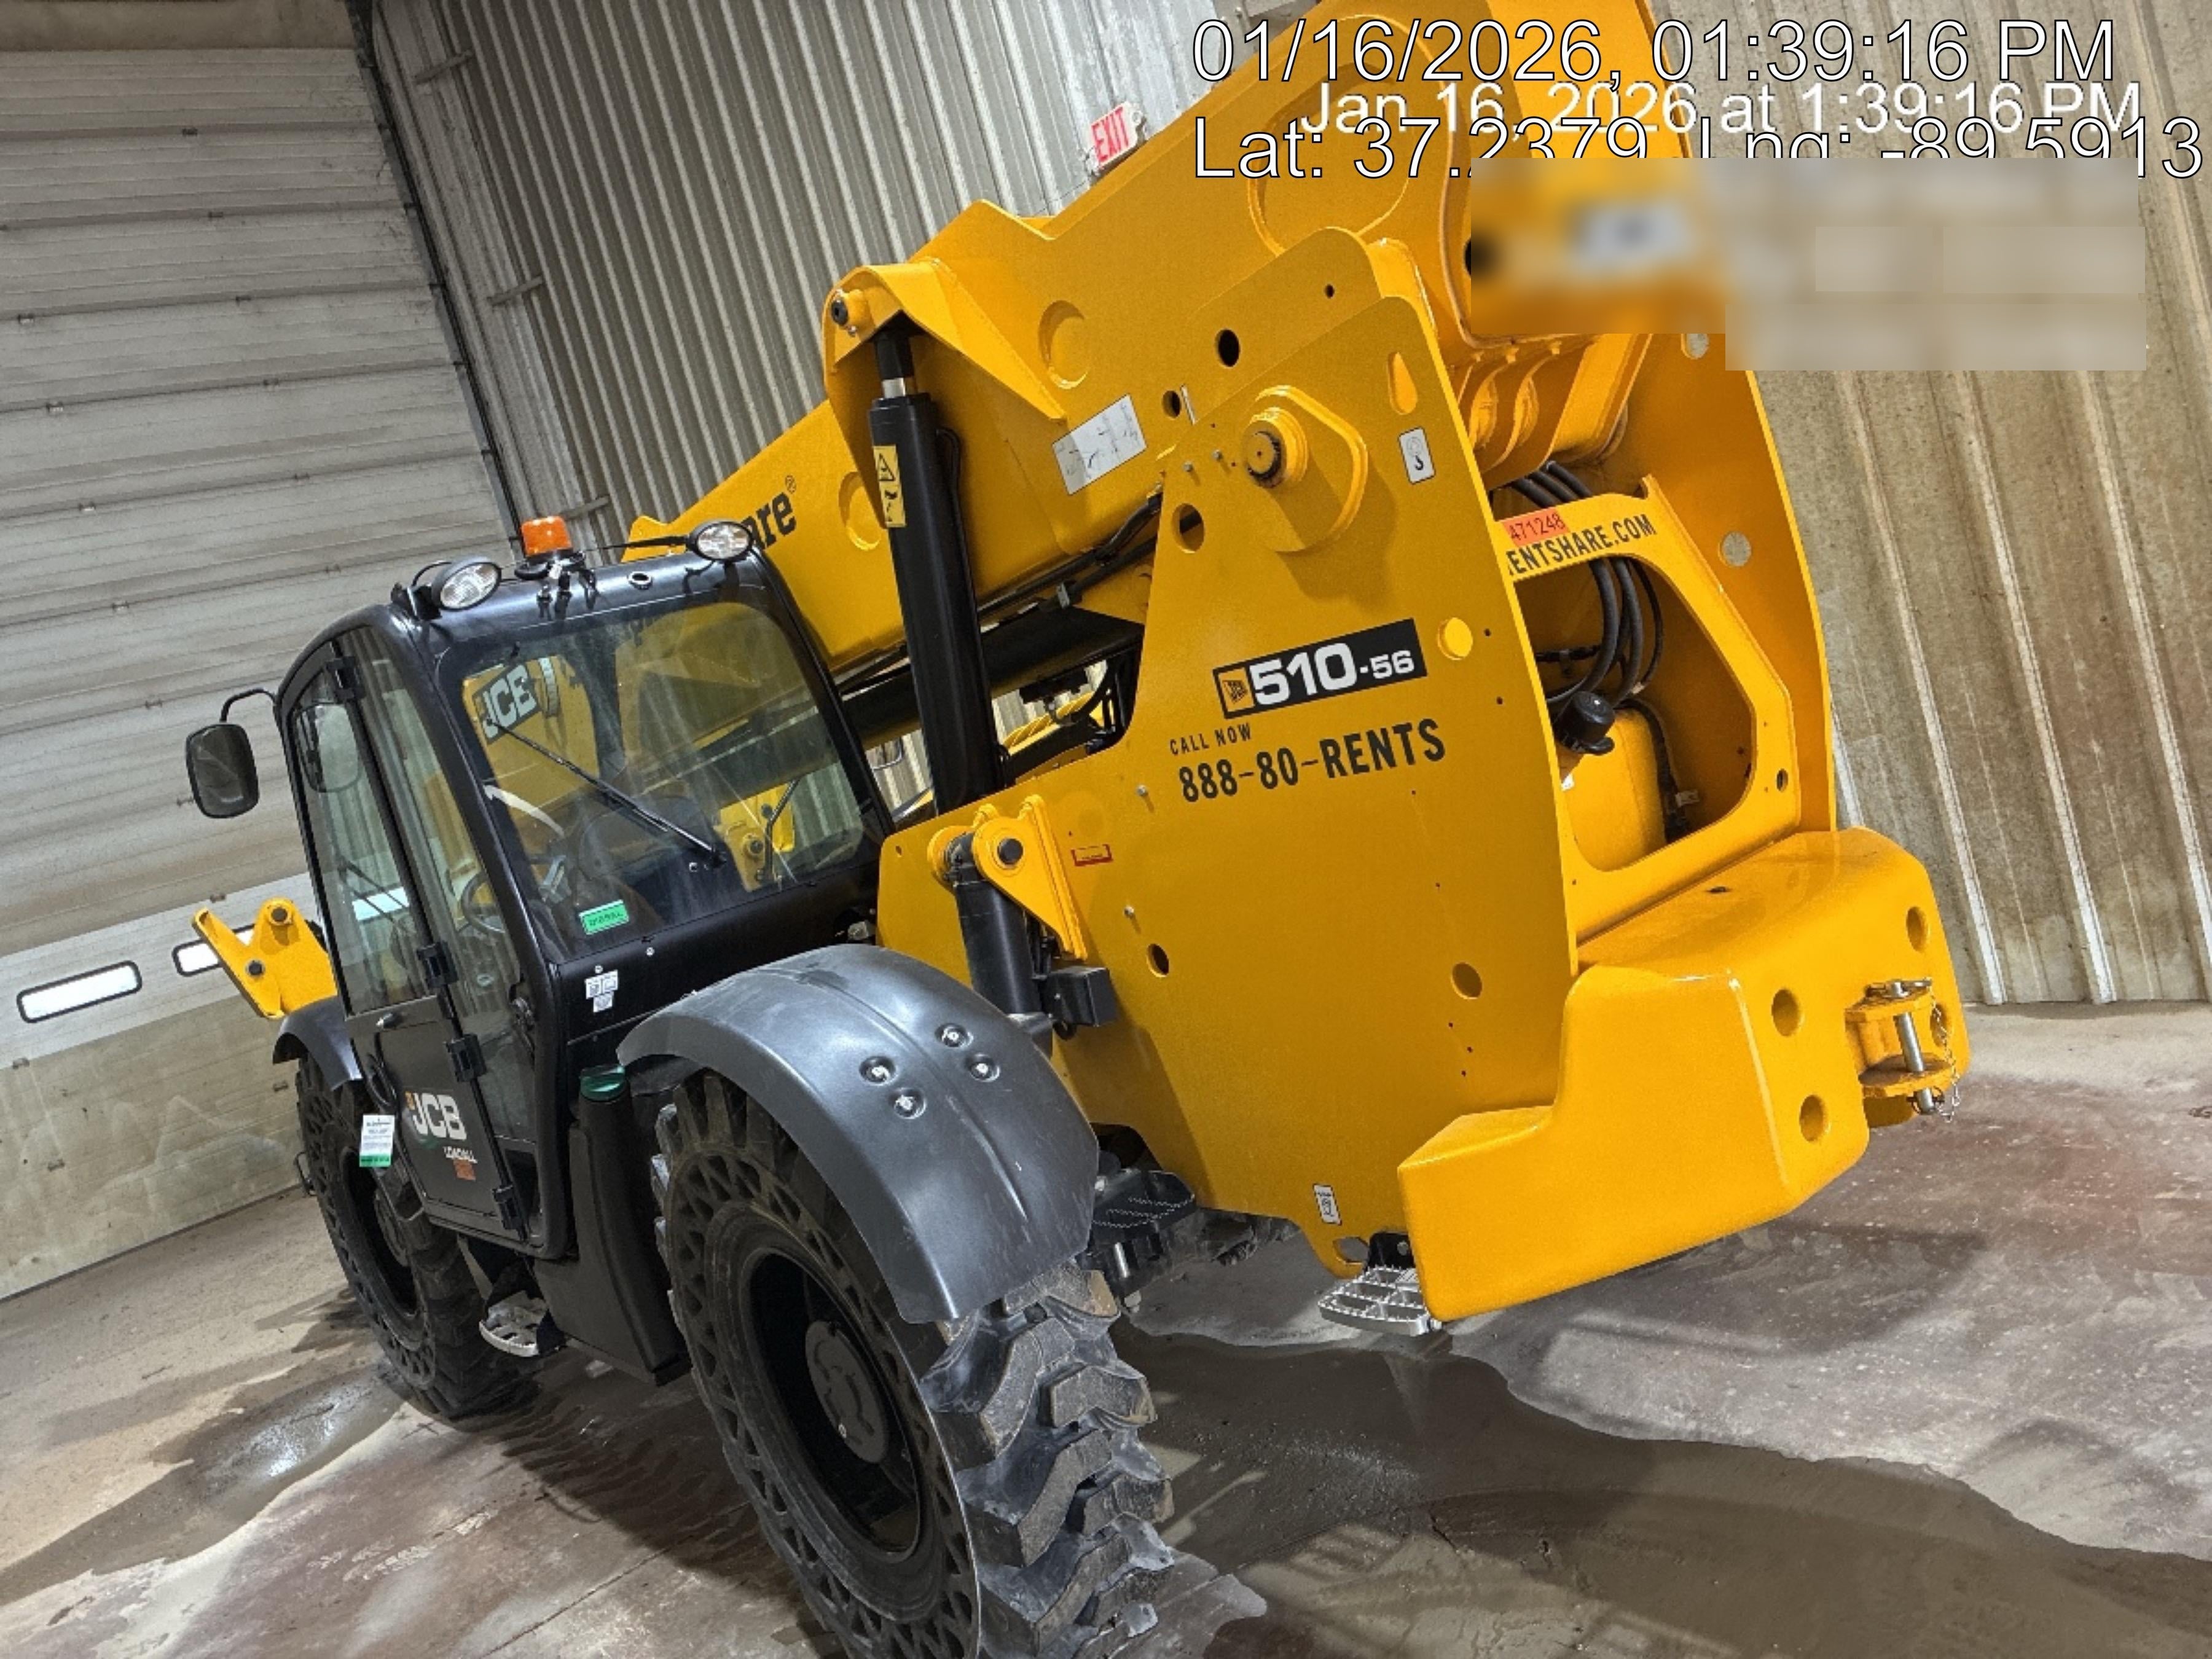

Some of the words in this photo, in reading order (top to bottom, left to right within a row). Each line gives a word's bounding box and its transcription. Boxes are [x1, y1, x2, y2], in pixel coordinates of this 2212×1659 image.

[1091, 106, 1129, 162] EXIT
[1507, 514, 1657, 576] ENTSHARE.COM
[1509, 513, 1566, 541] 471248
[1249, 643, 1415, 705] 510-56
[1169, 733, 1210, 756] CALL
[1214, 723, 1251, 746] NOW
[1179, 718, 1445, 802] 888-80-RENTS
[411, 1092, 468, 1140] JCB
